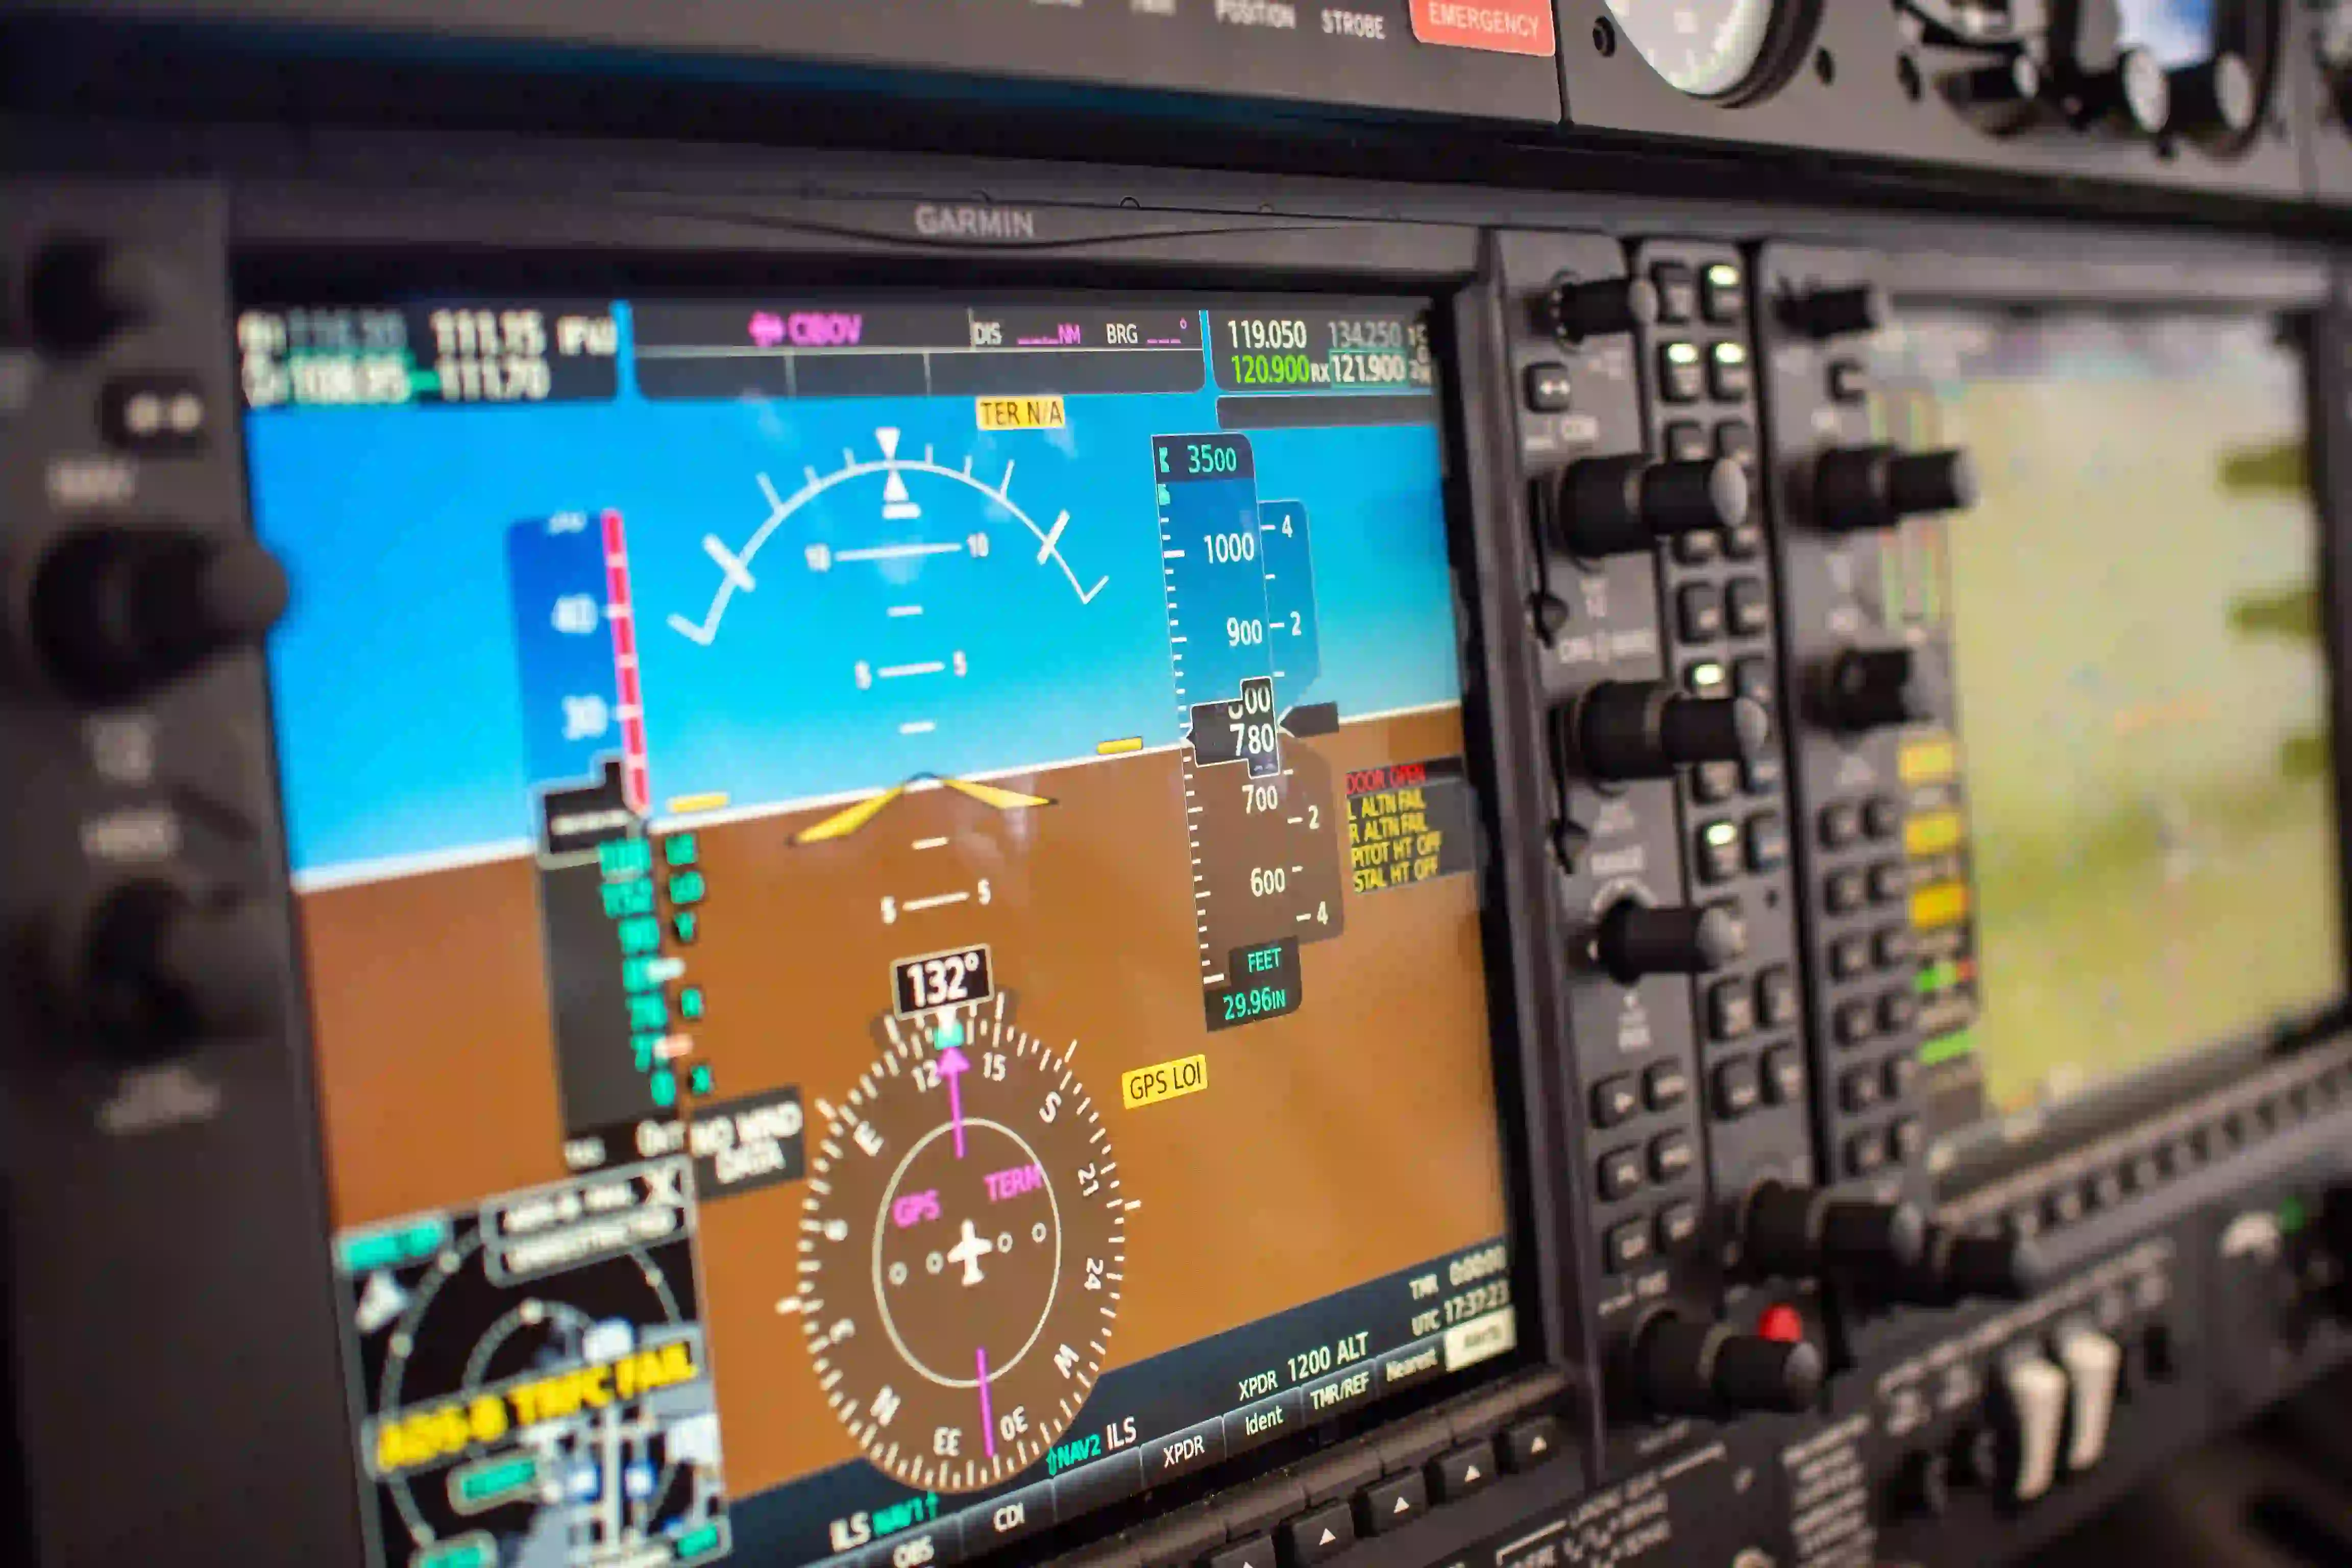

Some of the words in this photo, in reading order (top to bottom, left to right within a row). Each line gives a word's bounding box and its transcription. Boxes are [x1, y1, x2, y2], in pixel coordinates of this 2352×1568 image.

[1321, 10, 1385, 39] STROBE
[1429, 2, 1539, 40] EMERGENCY
[915, 203, 1034, 238] GARMIN
[973, 322, 1002, 345] DIS
[1106, 323, 1138, 344] BRG
[1228, 320, 1307, 349] 119.050
[1232, 355, 1309, 384] 120.900
[1311, 363, 1330, 383] RX
[1331, 354, 1406, 382] 121.900
[979, 402, 1020, 426] TER
[1027, 402, 1063, 426] N/A
[1187, 444, 1237, 473] 3500
[1282, 515, 1293, 537] 4
[1204, 532, 1255, 564] 1000
[1227, 617, 1262, 647] 900
[1290, 611, 1302, 636] 2
[1230, 723, 1274, 756] 780
[1345, 770, 1385, 795] DOOR
[1242, 785, 1278, 814] 700
[1308, 805, 1319, 829] 2
[1352, 842, 1389, 868] PITOT
[1250, 867, 1285, 897] 600
[1317, 901, 1328, 924] 4
[1247, 947, 1282, 973] FEET
[911, 1060, 942, 1093] 12
[983, 1052, 1007, 1082] 15
[1131, 1070, 1167, 1100] GPS
[1173, 1062, 1201, 1090] LOI
[1039, 1091, 1062, 1123] S
[1084, 1257, 1104, 1289] 24
[1411, 1308, 1441, 1337] UTC
[1054, 1343, 1079, 1378] W
[1239, 1369, 1278, 1402] XPDR
[1287, 1346, 1331, 1382] 1200
[1336, 1331, 1368, 1365] ALT
[1310, 1371, 1369, 1410] TMR/REF
[1245, 1405, 1284, 1436] Ident
[1057, 1434, 1101, 1468] NAV2
[1106, 1416, 1137, 1451] ILS
[1163, 1435, 1205, 1468] XPDR
[830, 1511, 872, 1553] ILS
[994, 1503, 1025, 1532] CDI
